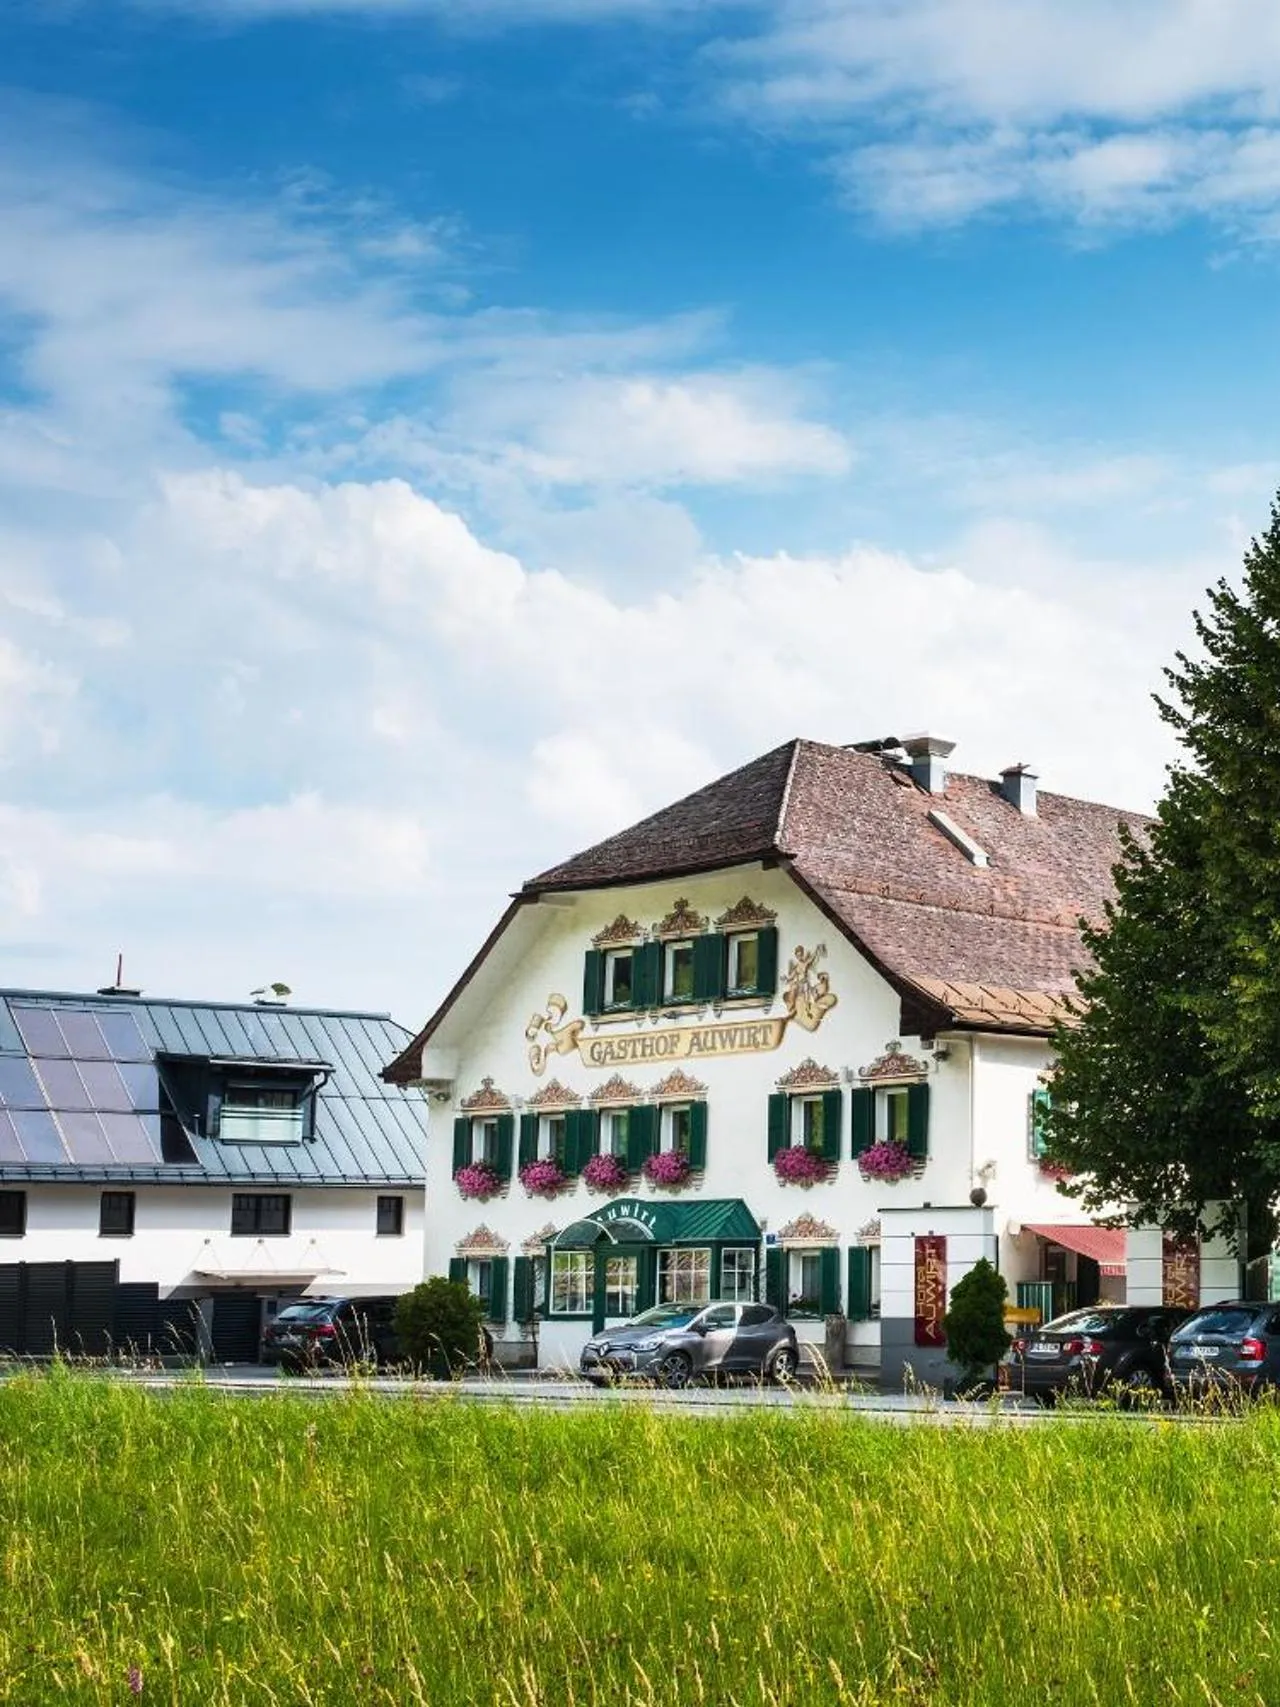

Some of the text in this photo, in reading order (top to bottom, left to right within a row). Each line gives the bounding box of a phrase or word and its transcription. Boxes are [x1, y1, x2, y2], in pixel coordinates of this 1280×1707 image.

[589, 1024, 772, 1065] GASTHOF AUWIRT
[597, 1203, 657, 1229] uwirt
[916, 1266, 926, 1317] Hotel
[925, 1243, 937, 1339] AUWIRT
